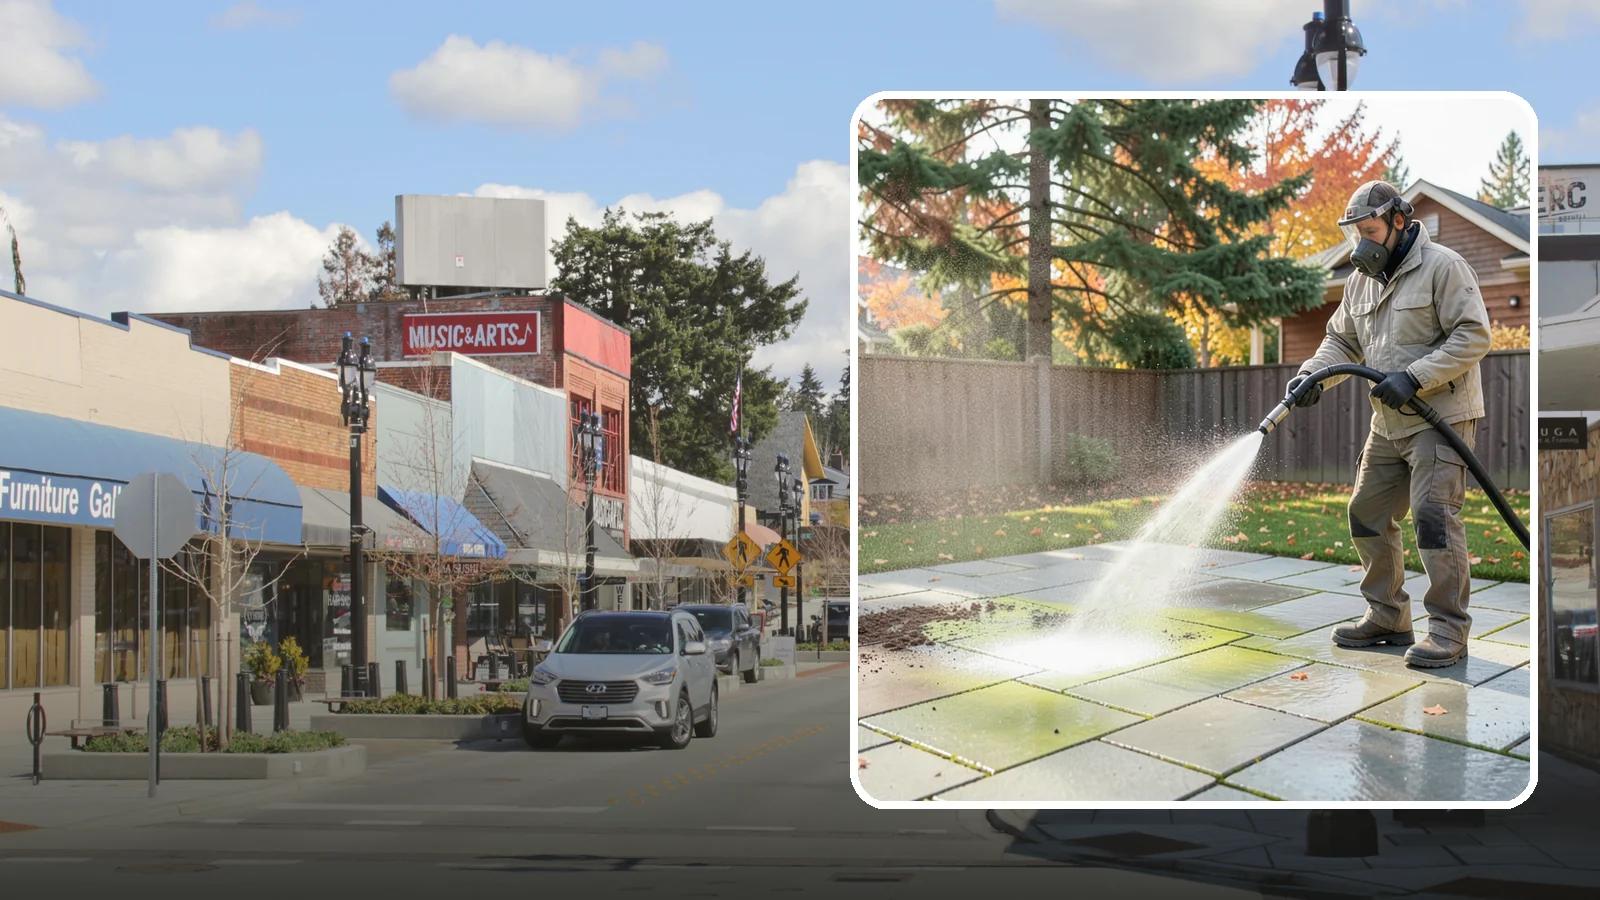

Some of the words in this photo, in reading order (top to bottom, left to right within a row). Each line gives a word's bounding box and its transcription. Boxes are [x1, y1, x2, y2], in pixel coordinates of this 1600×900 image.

[409, 323, 519, 349] MUSIC&ARTS
[1540, 428, 1577, 436] UGA
[0, 471, 79, 515] Furniture
[89, 482, 122, 519] Gal
